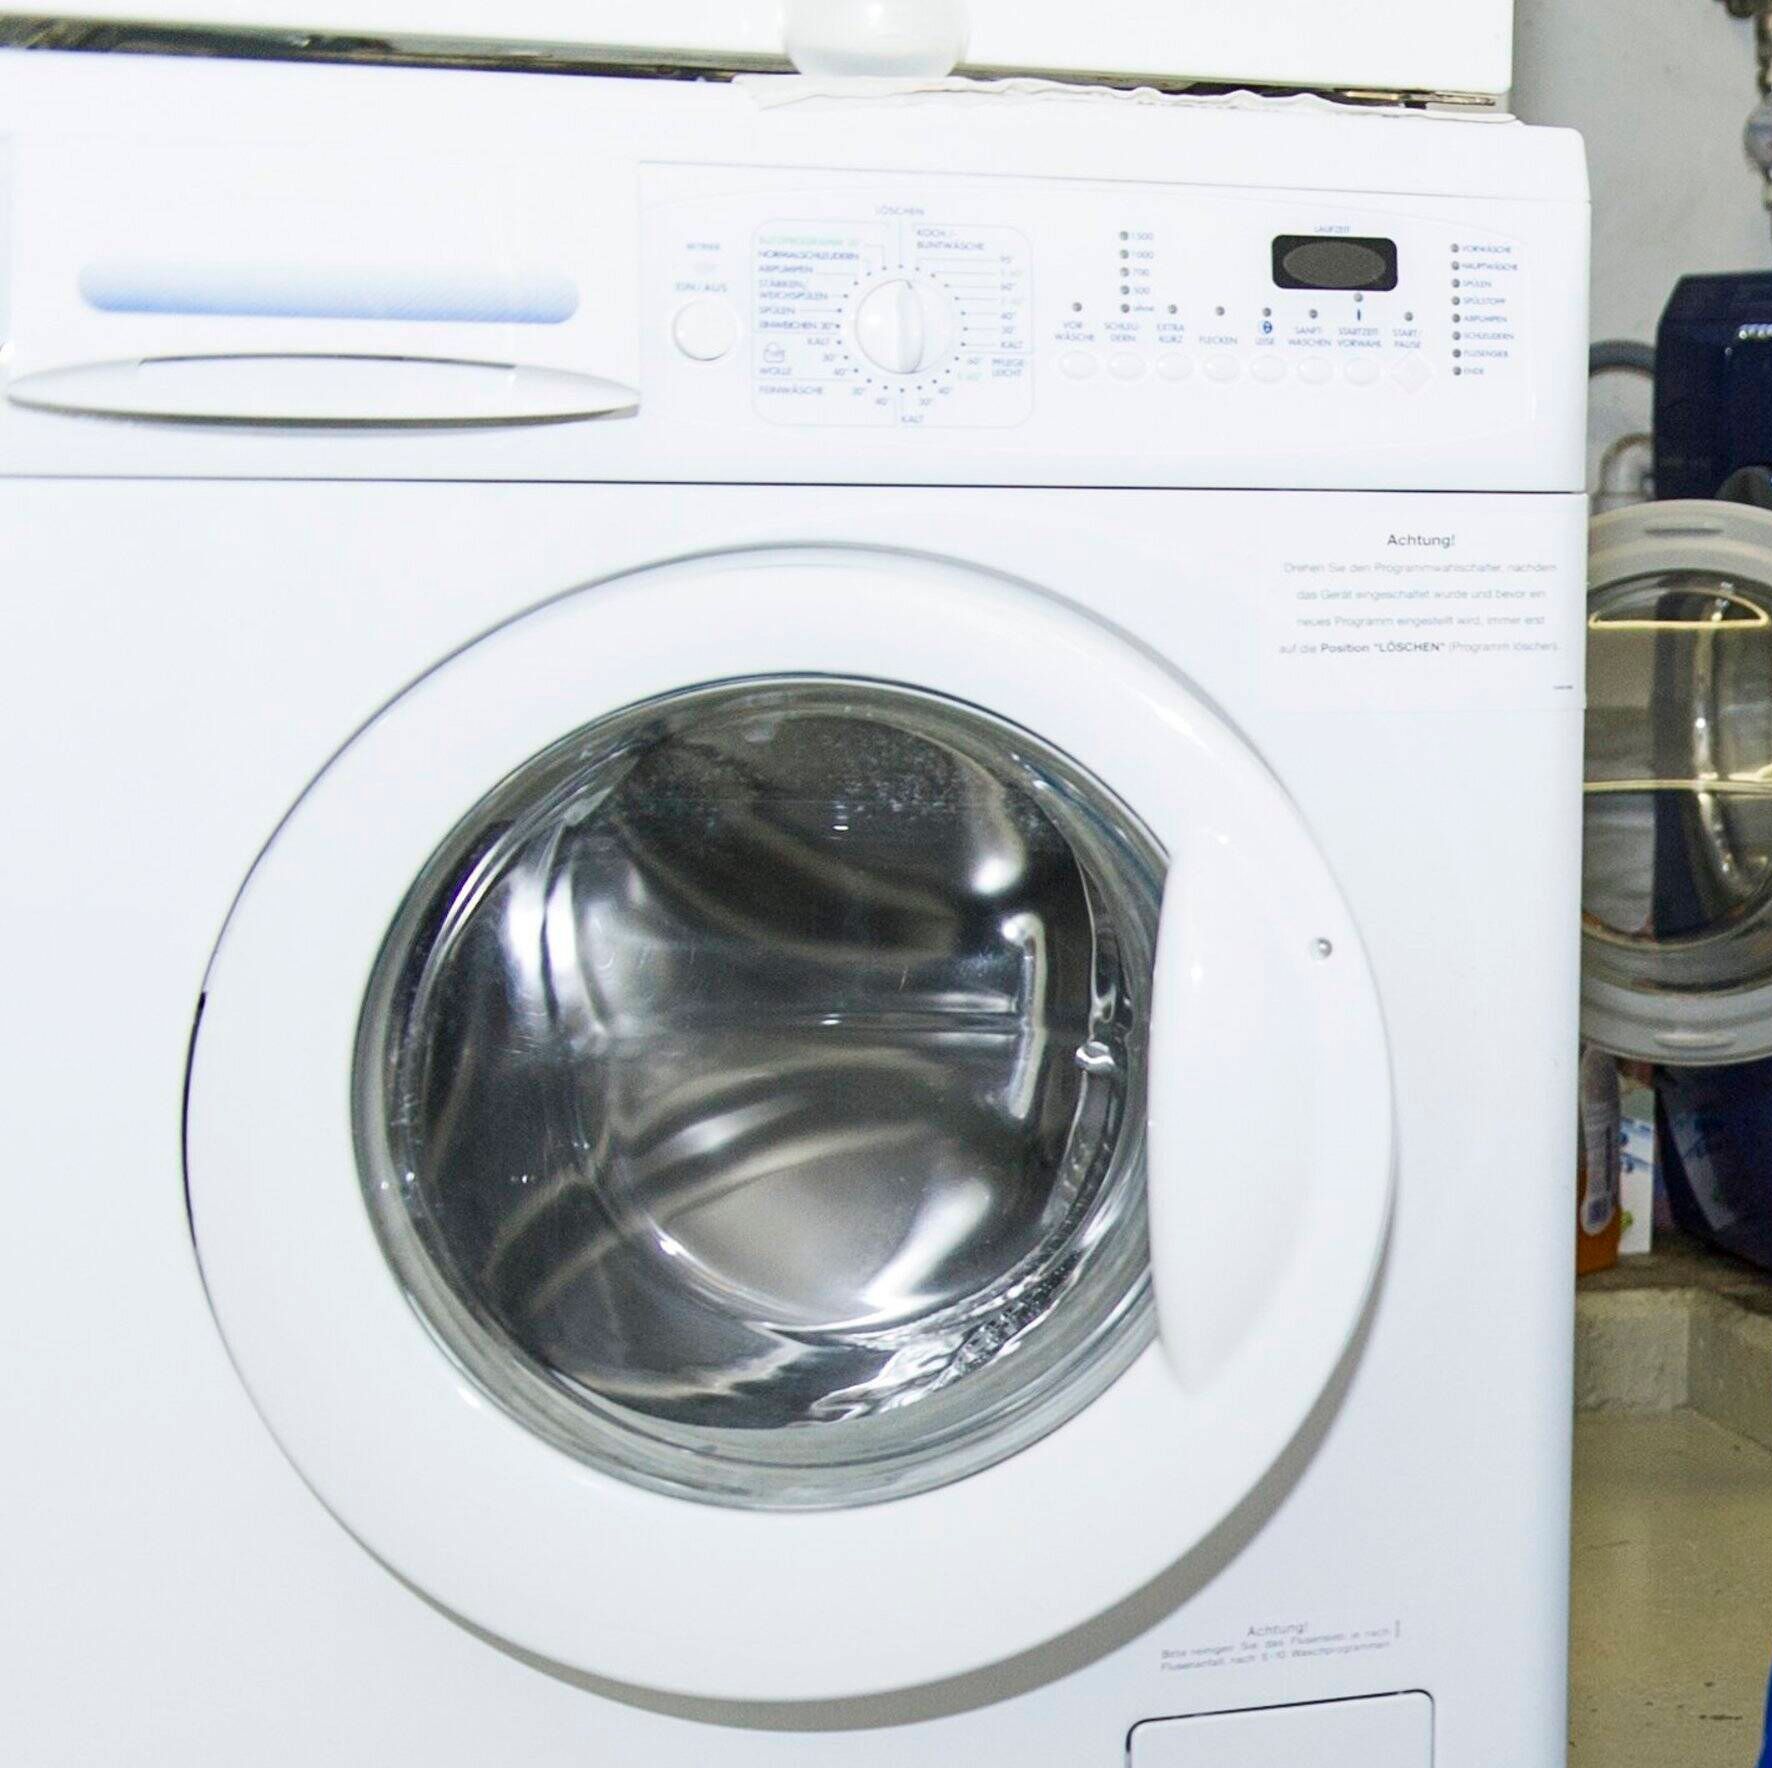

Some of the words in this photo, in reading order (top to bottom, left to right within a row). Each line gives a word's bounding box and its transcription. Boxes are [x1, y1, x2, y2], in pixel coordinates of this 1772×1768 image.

[1387, 534, 1456, 549] Achtung!
[1283, 561, 1324, 573] Drehen
[1329, 562, 1346, 573] Sie
[1349, 563, 1371, 573] den
[1296, 590, 1318, 600] das
[1320, 589, 1352, 600] Gerät
[1434, 589, 1468, 600] wurde
[1471, 589, 1492, 599] und
[1495, 589, 1526, 599] bevor
[1529, 589, 1546, 599] ein
[1296, 617, 1332, 626] neues
[1334, 616, 1393, 628] Programm
[1279, 643, 1296, 654] auf
[1299, 644, 1317, 653] die
[1320, 642, 1370, 653] Position
[1374, 639, 1445, 653] "LÖSCHEN"
[1247, 1620, 1308, 1637] Achtung!
